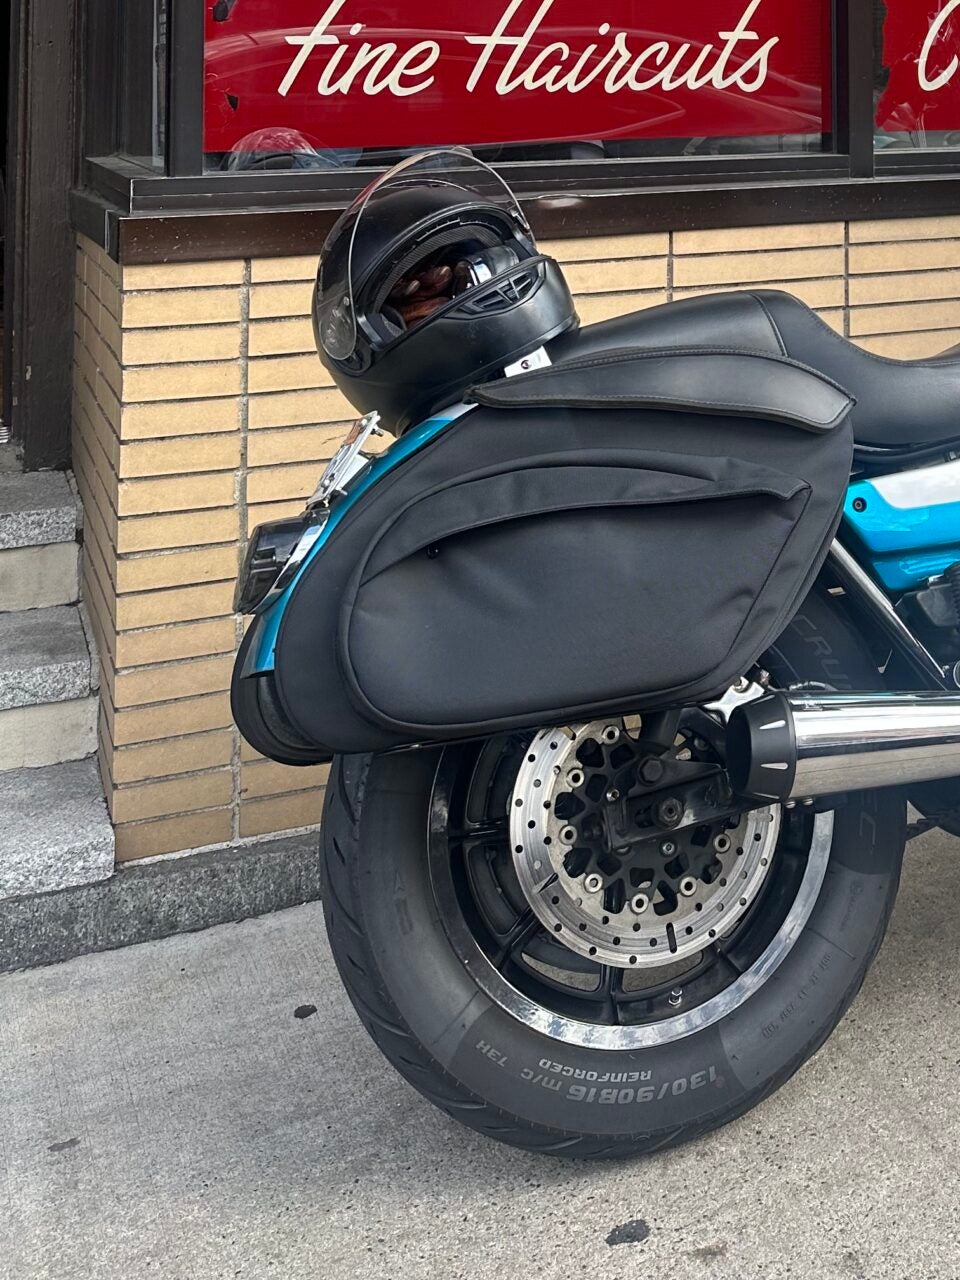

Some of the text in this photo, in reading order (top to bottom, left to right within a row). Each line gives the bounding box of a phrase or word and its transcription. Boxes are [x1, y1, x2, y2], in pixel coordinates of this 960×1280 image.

[475, 1039, 509, 1067] 73H
[538, 1058, 652, 1083] REINFORCED
[566, 1065, 718, 1105] 130/90B16
